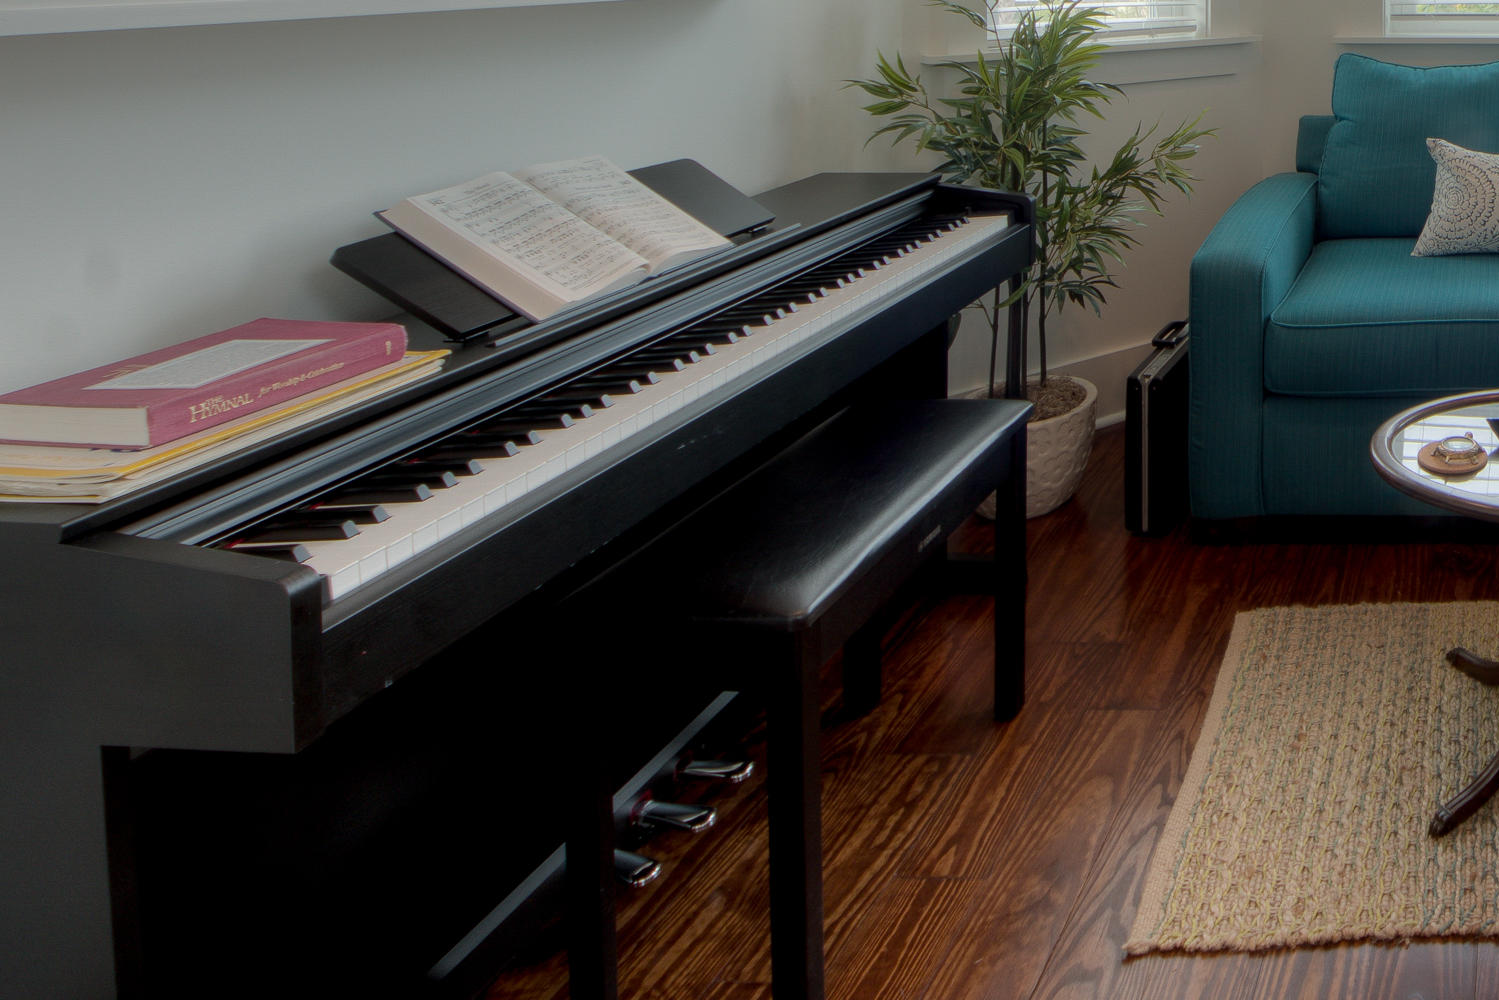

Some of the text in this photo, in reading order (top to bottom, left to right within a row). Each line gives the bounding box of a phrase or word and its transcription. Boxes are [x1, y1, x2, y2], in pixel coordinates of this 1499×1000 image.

[258, 387, 272, 399] for
[272, 376, 300, 391] Worship
[306, 362, 345, 379] Celebration
[189, 393, 255, 424] HYMNAL
[206, 394, 225, 407] THE
